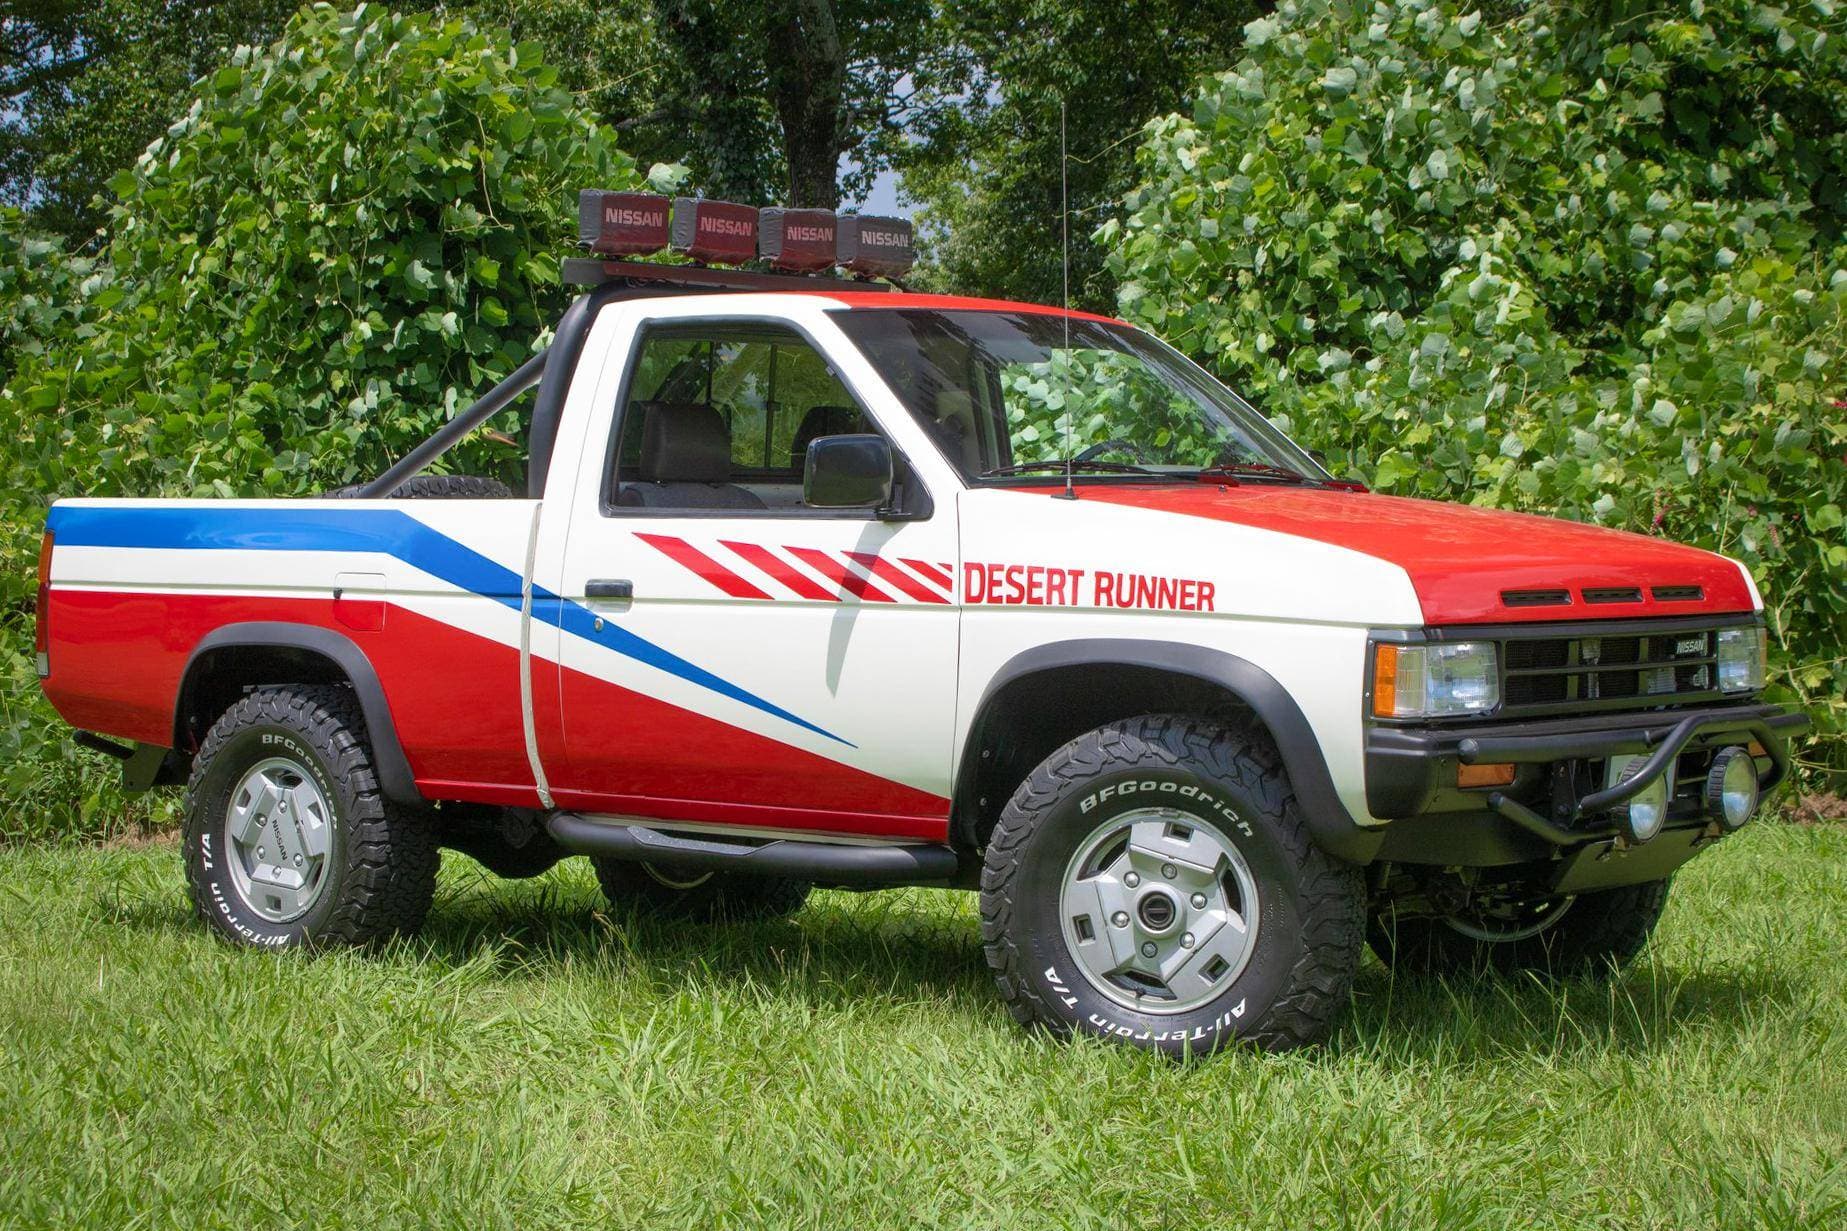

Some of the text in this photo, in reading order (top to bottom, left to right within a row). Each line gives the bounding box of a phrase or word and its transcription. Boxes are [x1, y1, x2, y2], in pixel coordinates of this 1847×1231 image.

[605, 207, 663, 227] NISSAN
[700, 216, 752, 237] NISSAN
[787, 225, 833, 242] NISSAN
[861, 230, 908, 248] NISSAN
[964, 562, 1215, 612] DESERT RUNNER
[1676, 639, 1705, 655] NISSAN
[262, 734, 338, 830] BFGoodrich
[1080, 780, 1253, 838] BFGoodrich
[272, 819, 288, 861] NISSAN
[202, 833, 290, 945] All-Terrain T/A
[1044, 966, 1247, 1041] All-Terrain T/A
